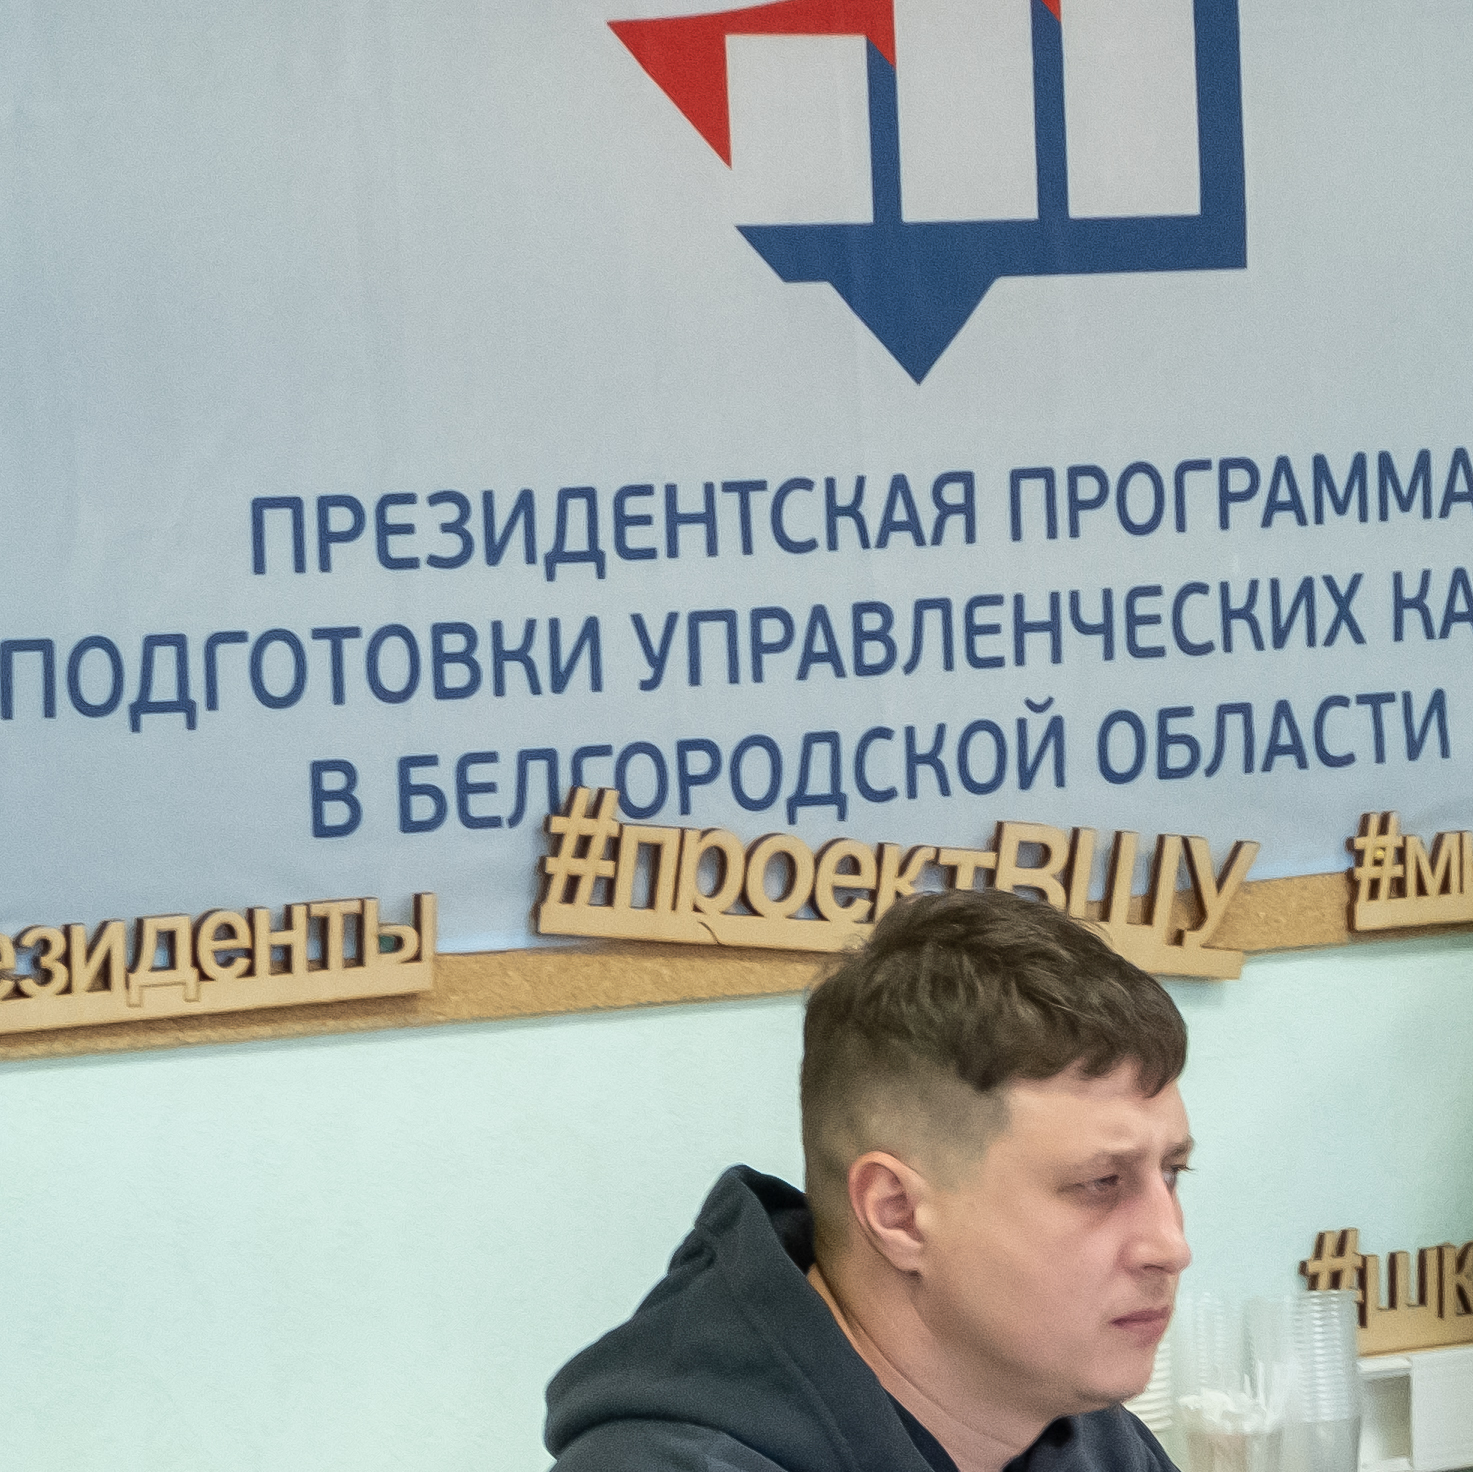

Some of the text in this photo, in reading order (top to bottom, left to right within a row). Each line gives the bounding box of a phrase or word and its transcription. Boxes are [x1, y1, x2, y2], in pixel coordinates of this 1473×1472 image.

[251, 468, 977, 583] ПРЕЗИДЕНТСКАЯ
[0, 614, 604, 735] ПОДГОТОВКИ
[630, 573, 1366, 692] УПРАВЛЕНЧЕСКИХ
[308, 688, 1452, 840] В БЕЛГОРОДСКОЙ ОБЛАСТИ
